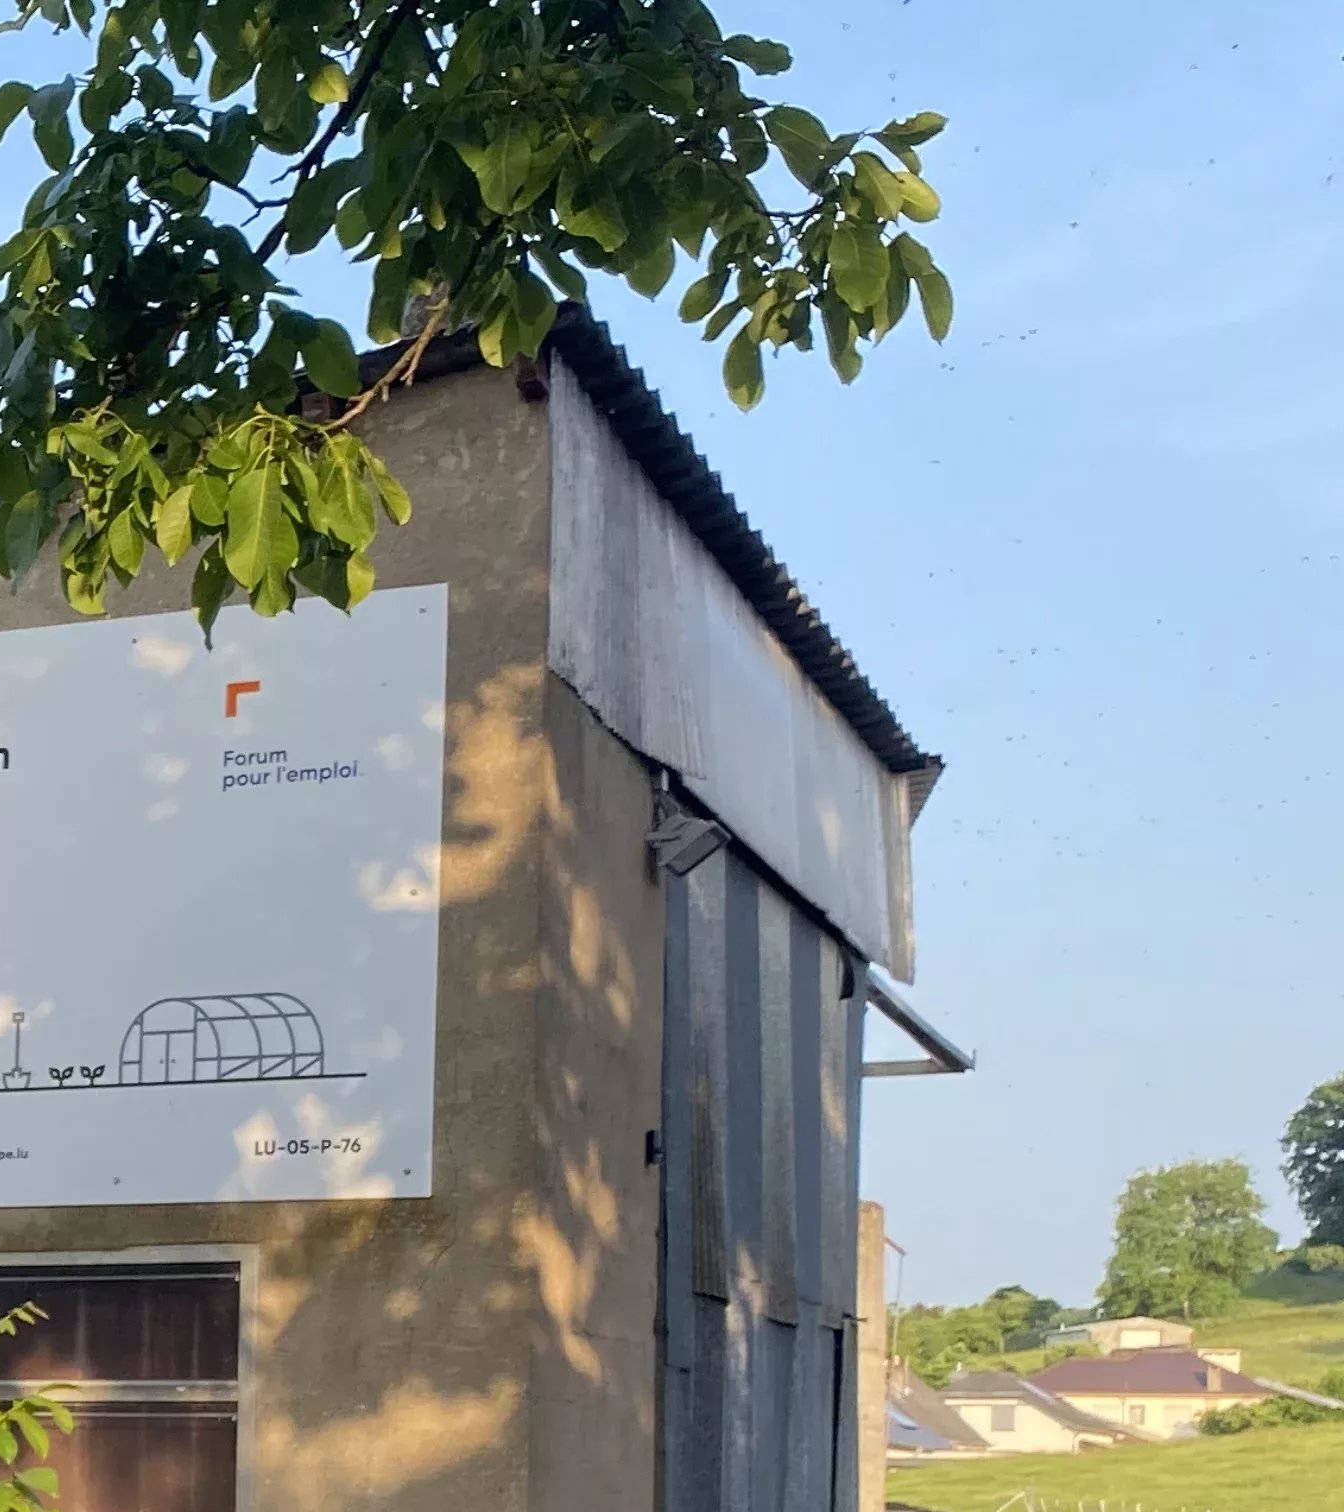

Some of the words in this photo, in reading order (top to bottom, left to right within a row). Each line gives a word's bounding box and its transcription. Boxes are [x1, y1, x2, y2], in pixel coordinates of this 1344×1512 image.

[223, 749, 288, 767] Forum
[222, 772, 271, 791] pour
[276, 759, 360, 784] l'emploi
[254, 1137, 362, 1156] LU-05-P-76
